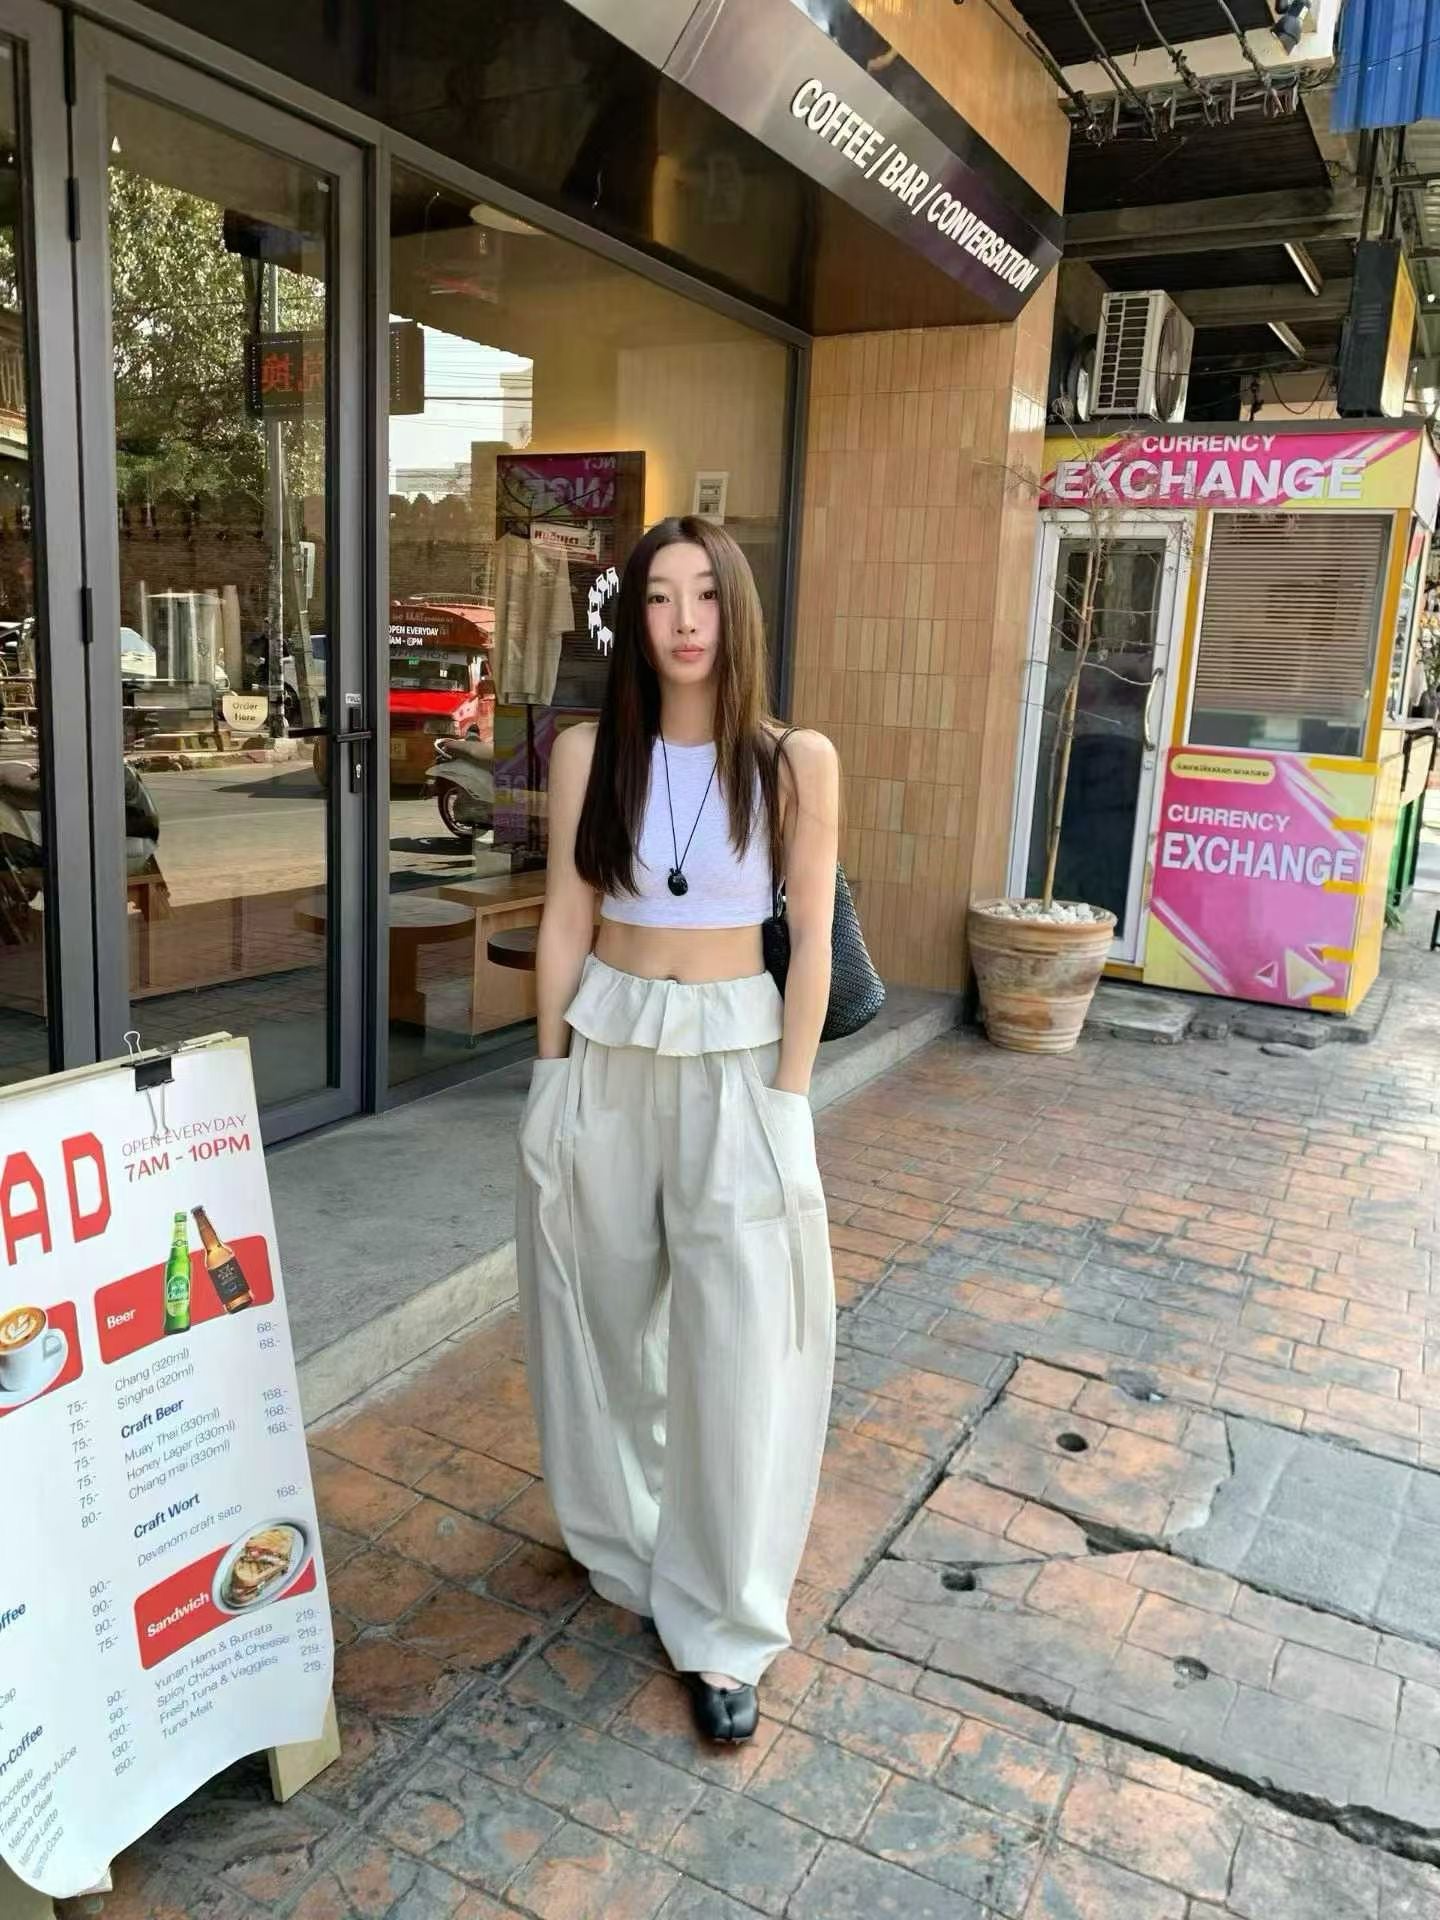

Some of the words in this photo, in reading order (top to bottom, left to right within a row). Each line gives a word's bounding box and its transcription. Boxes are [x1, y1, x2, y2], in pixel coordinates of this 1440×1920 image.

[790, 79, 885, 169] COFFEE
[878, 151, 930, 207] BAR
[927, 192, 1040, 293] CONVERSATION
[1141, 434, 1276, 454] CURRENCY
[1054, 457, 1368, 501] EXCHANGE
[1167, 803, 1290, 833] CURRENCY
[1161, 831, 1359, 886] EXCHANGE
[122, 1134, 161, 1156] OPEN
[165, 1114, 247, 1143] EVERYDAY
[124, 1152, 170, 1183] 7AM
[188, 1134, 251, 1162] 10PM
[0, 1132, 111, 1266] AD
[107, 1308, 136, 1329] Beer
[114, 1368, 150, 1392] Chang
[117, 1385, 154, 1410] Singha
[121, 1413, 153, 1439] Craft
[156, 1399, 185, 1421] Beer
[124, 1444, 154, 1464] Muay
[126, 1457, 161, 1482] Honey
[129, 1474, 166, 1500] Chiang
[168, 1460, 188, 1477] mai
[134, 1513, 166, 1539] Craft
[168, 1493, 201, 1518] Wort
[190, 1514, 216, 1537] craft
[217, 1503, 242, 1521] sato
[147, 1592, 210, 1637] Sandwich
[229, 1623, 273, 1648] Burrata
[157, 1684, 185, 1708] Spicy
[188, 1655, 232, 1687] Chicken
[159, 1698, 189, 1724] Fresh
[191, 1678, 218, 1702] Tuna
[161, 1717, 188, 1740] Tuna
[189, 1699, 214, 1721] Melt
